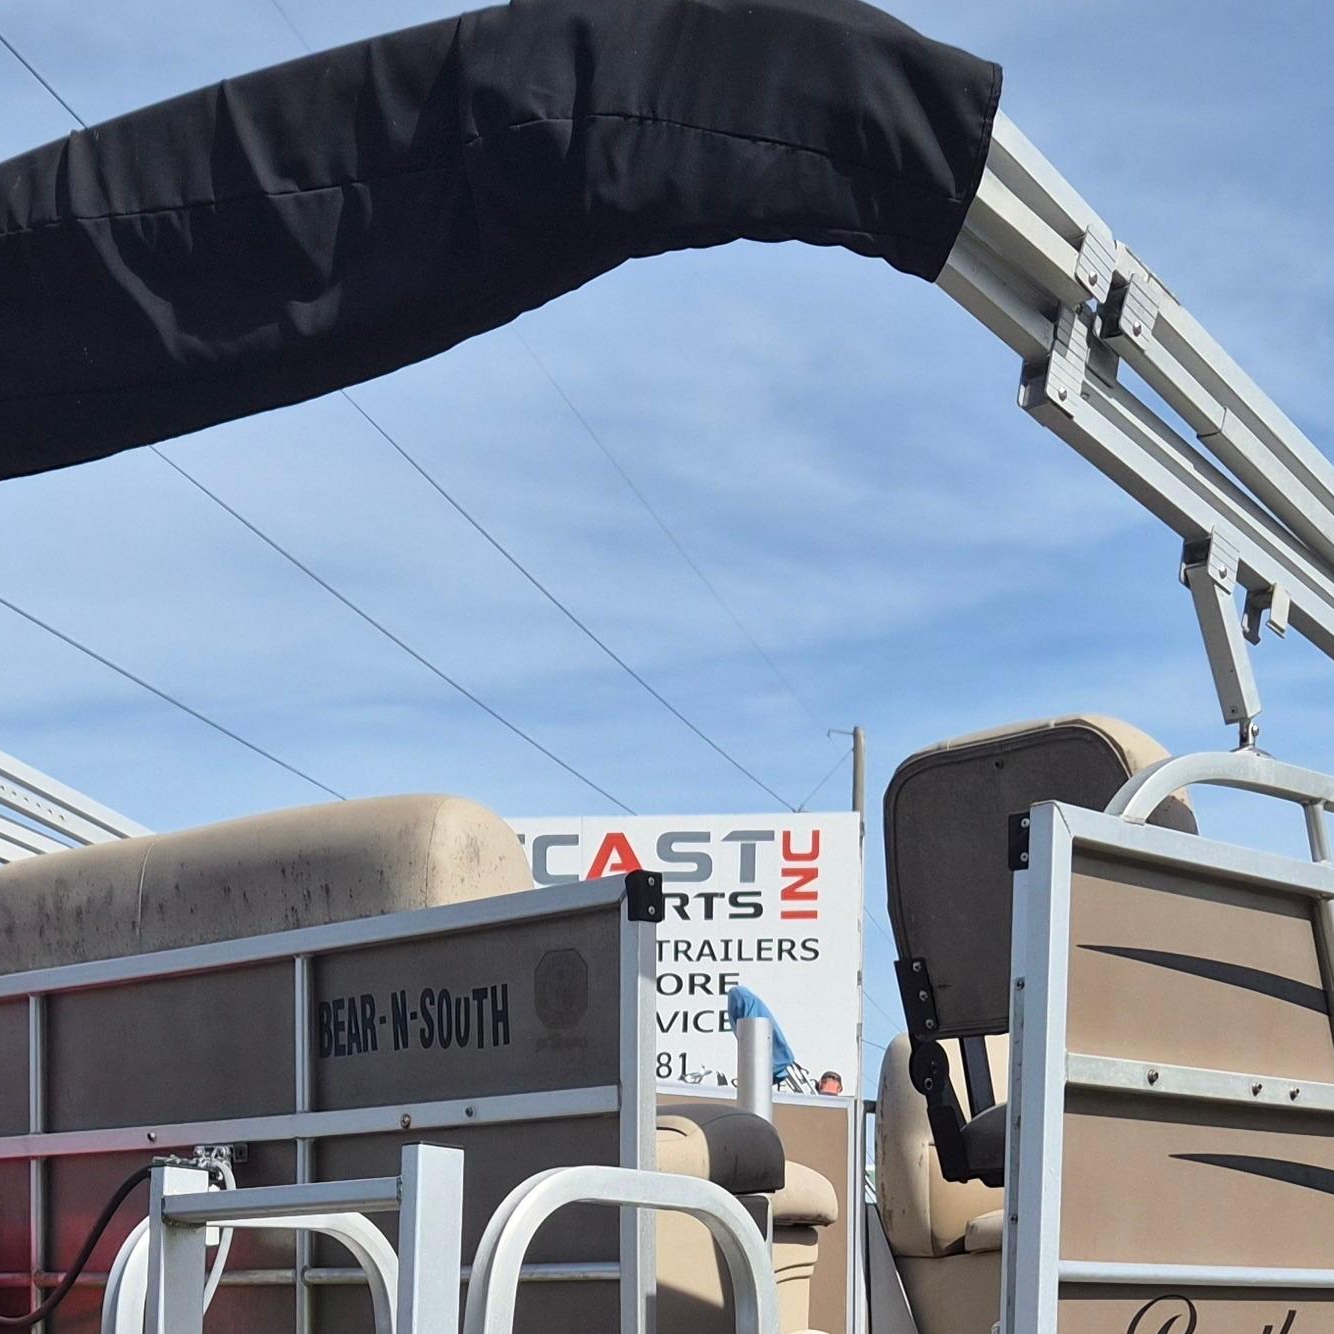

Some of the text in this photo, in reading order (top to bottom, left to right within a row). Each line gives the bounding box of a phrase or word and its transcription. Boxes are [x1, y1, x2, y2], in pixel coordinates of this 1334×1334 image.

[517, 829, 775, 885] CAST
[780, 830, 820, 920] INC
[657, 937, 820, 962] TRAILERS
